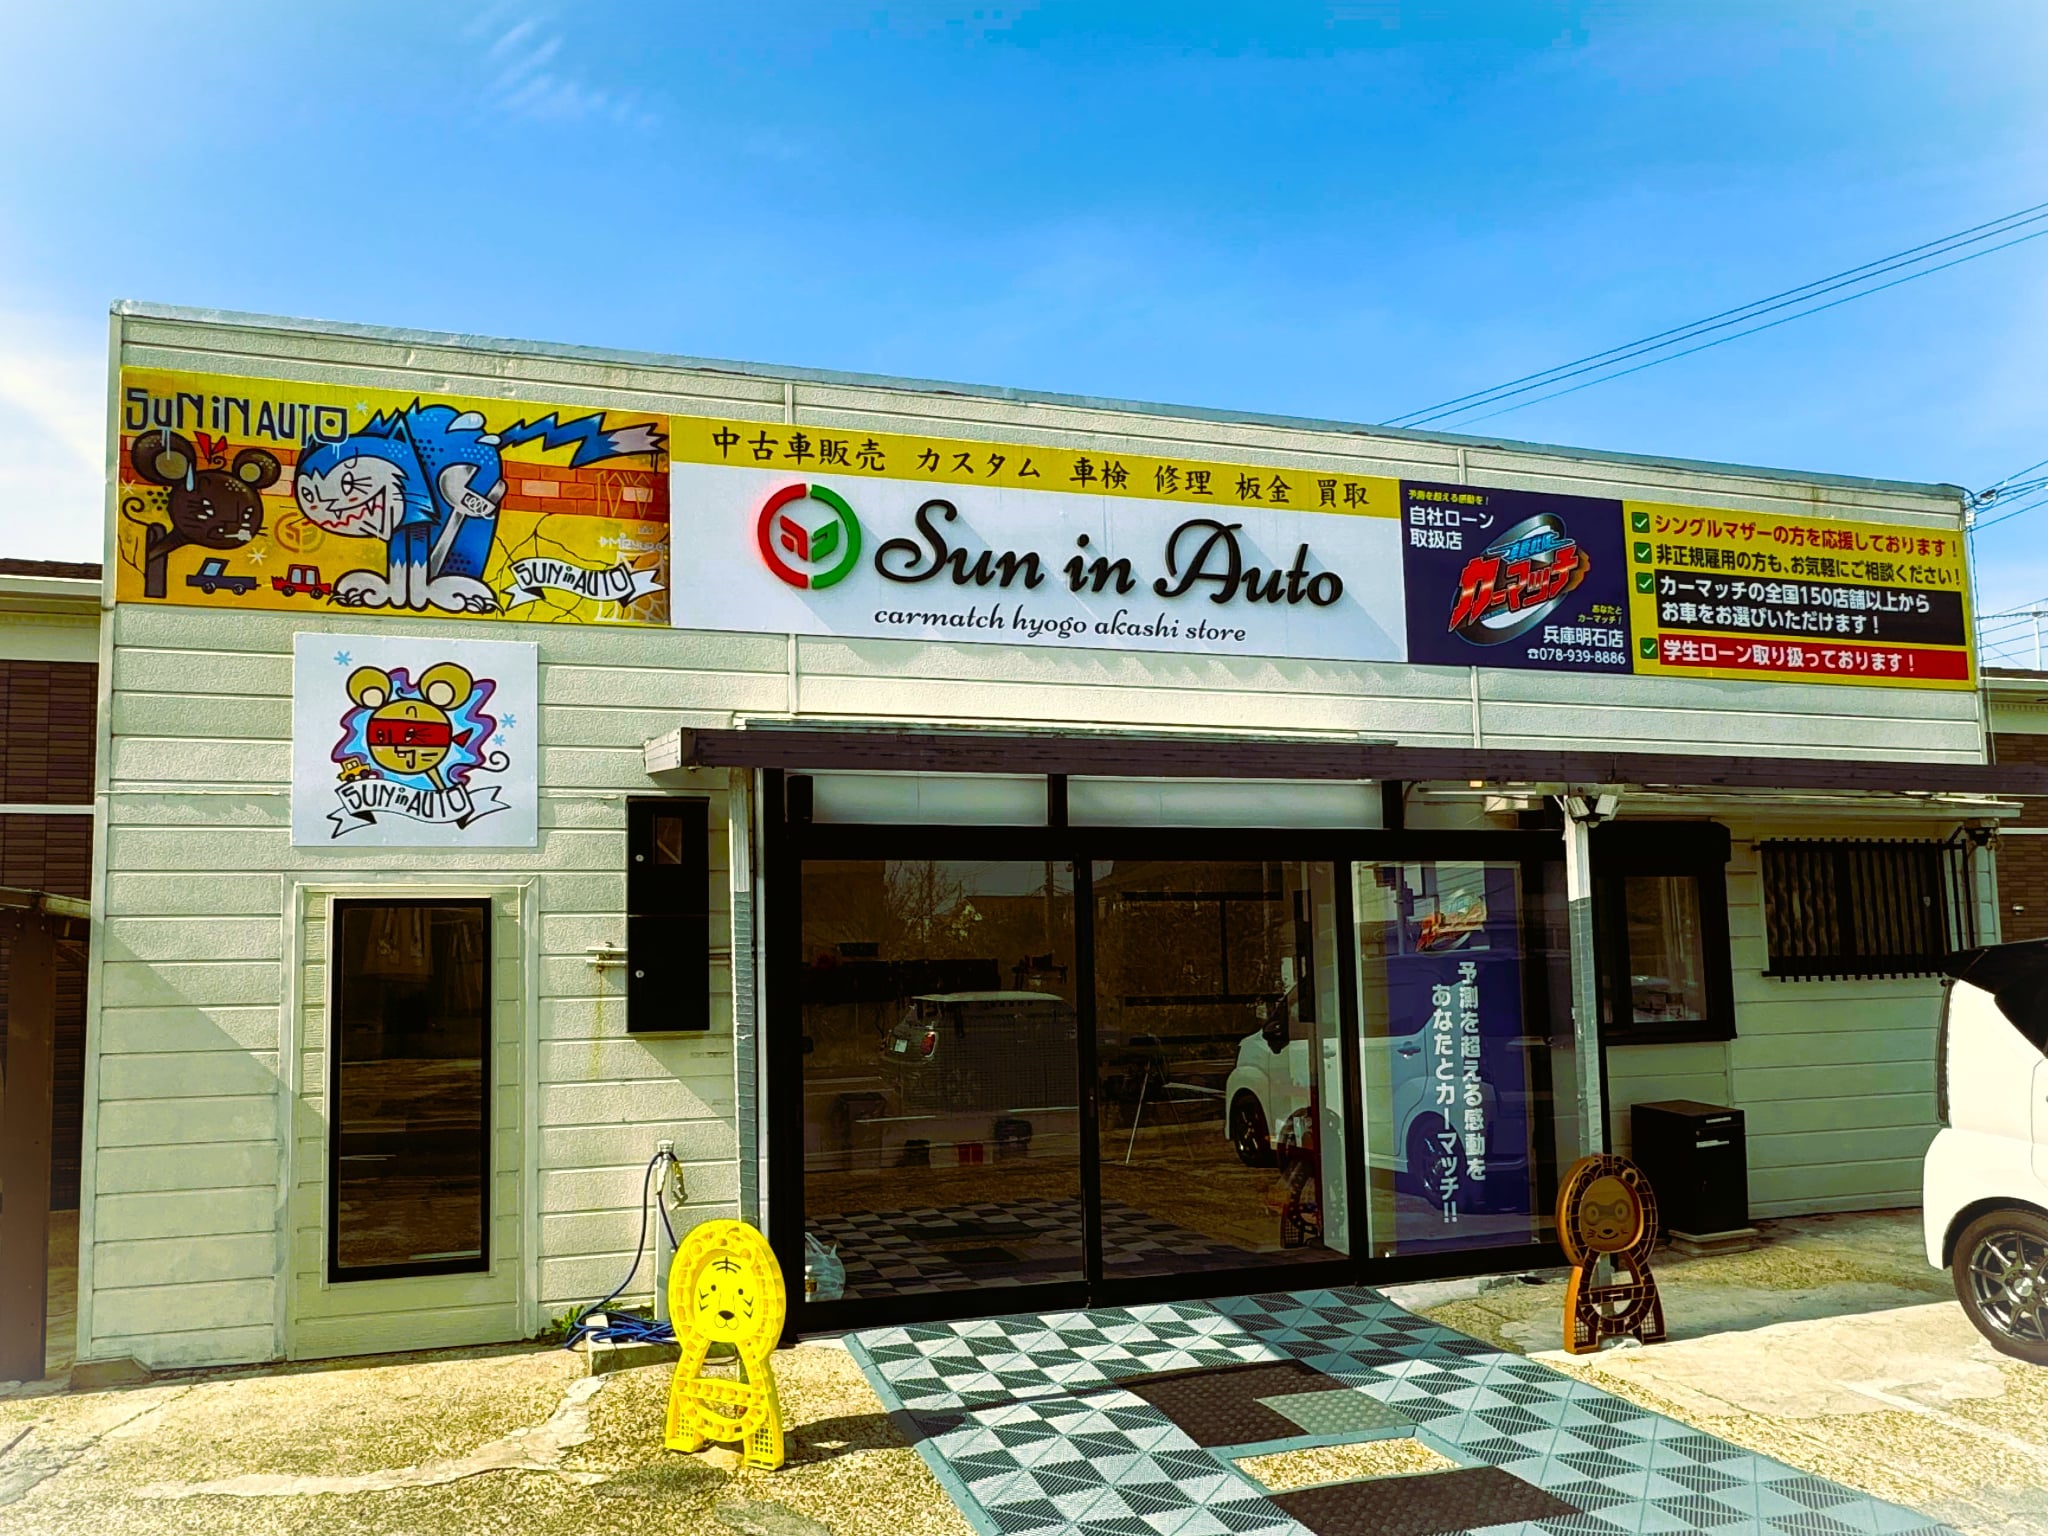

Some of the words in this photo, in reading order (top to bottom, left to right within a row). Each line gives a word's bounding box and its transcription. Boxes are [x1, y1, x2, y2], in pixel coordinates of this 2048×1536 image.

[256, 400, 348, 449] AUTO
[712, 426, 886, 472] 中古車販売
[915, 447, 1041, 479] カスタム
[1069, 457, 1130, 490] 車検
[1153, 464, 1214, 496] 修理
[1235, 472, 1293, 504] 板金
[1317, 478, 1370, 509] 買取
[1409, 506, 1494, 529] 自社ローン
[1655, 514, 1958, 558] シングルマザーの方を応援しております！
[874, 498, 1045, 589] Sun
[1064, 534, 1136, 594] in
[1153, 518, 1344, 606] Auto
[1409, 528, 1462, 550] 取扱店
[513, 562, 563, 586] SUN
[562, 565, 576, 584] in
[573, 568, 628, 597] AUTO
[1656, 543, 1961, 586] 非正規雇用の方も、お気軽にご相談ください!
[1448, 545, 1579, 632] カーマッチ
[1660, 575, 1930, 614] カーマッチの全国150店舗以上から
[874, 602, 1006, 630] carmatch
[1011, 605, 1087, 639] hyogo
[1094, 609, 1180, 640] akashi
[1185, 621, 1247, 643] store
[1591, 604, 1623, 615] あなたと
[1661, 601, 1880, 635] お車をお選びいただけます！
[1539, 647, 1626, 665] 078-939-8886
[1543, 625, 1624, 648] 兵庫明石店
[1663, 639, 1916, 672] 学生ローン取り扱っております！
[342, 784, 395, 810] SUN
[395, 787, 408, 806] in
[406, 785, 468, 818] AUTO
[1457, 961, 1486, 1181] 予測を超える感動を
[1432, 983, 1459, 1223] あなたとカーマッチ!!
